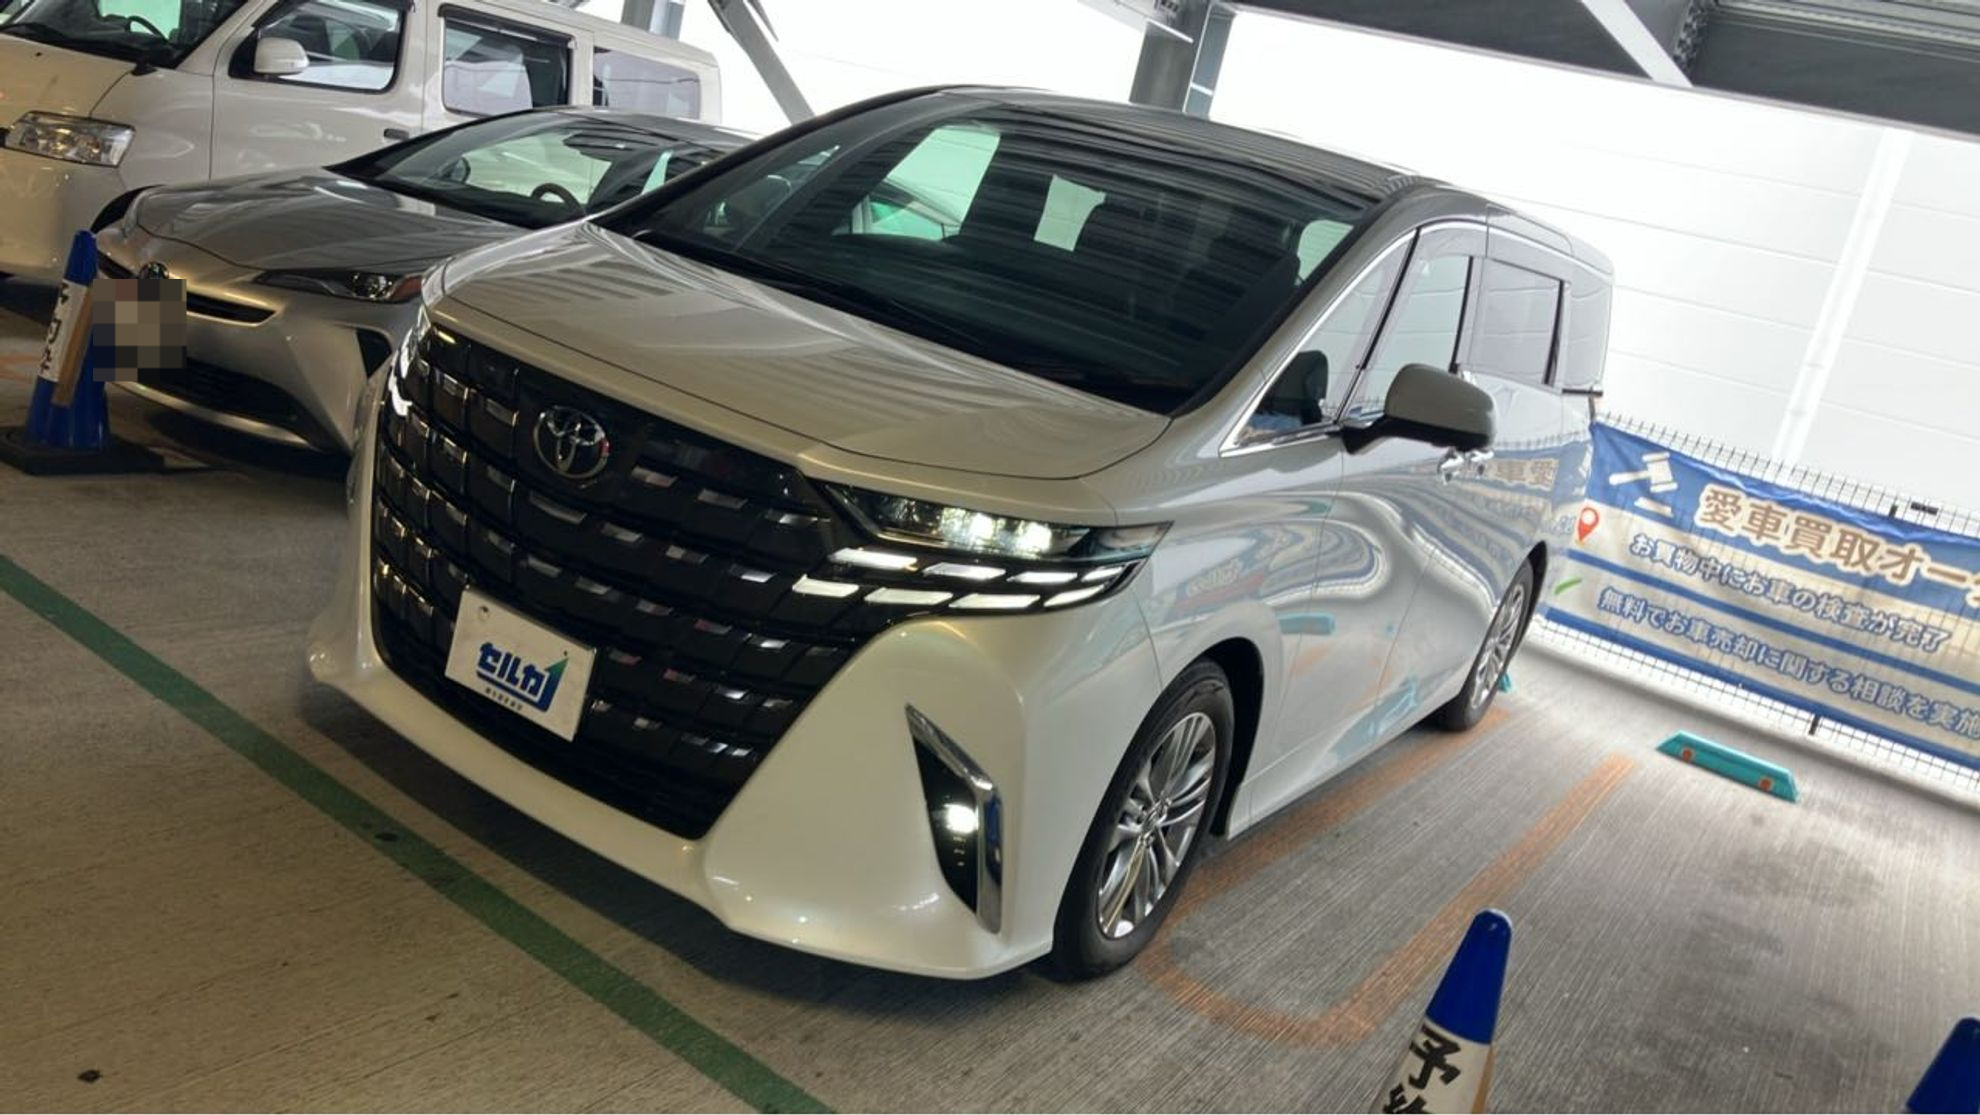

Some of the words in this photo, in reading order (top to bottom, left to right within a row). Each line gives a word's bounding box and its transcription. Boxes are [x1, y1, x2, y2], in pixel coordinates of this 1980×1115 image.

[1630, 534, 1952, 653] お買物中にお車の検査が完了
[1698, 486, 1980, 604] 愛車買取オー
[477, 642, 550, 701] セルカ
